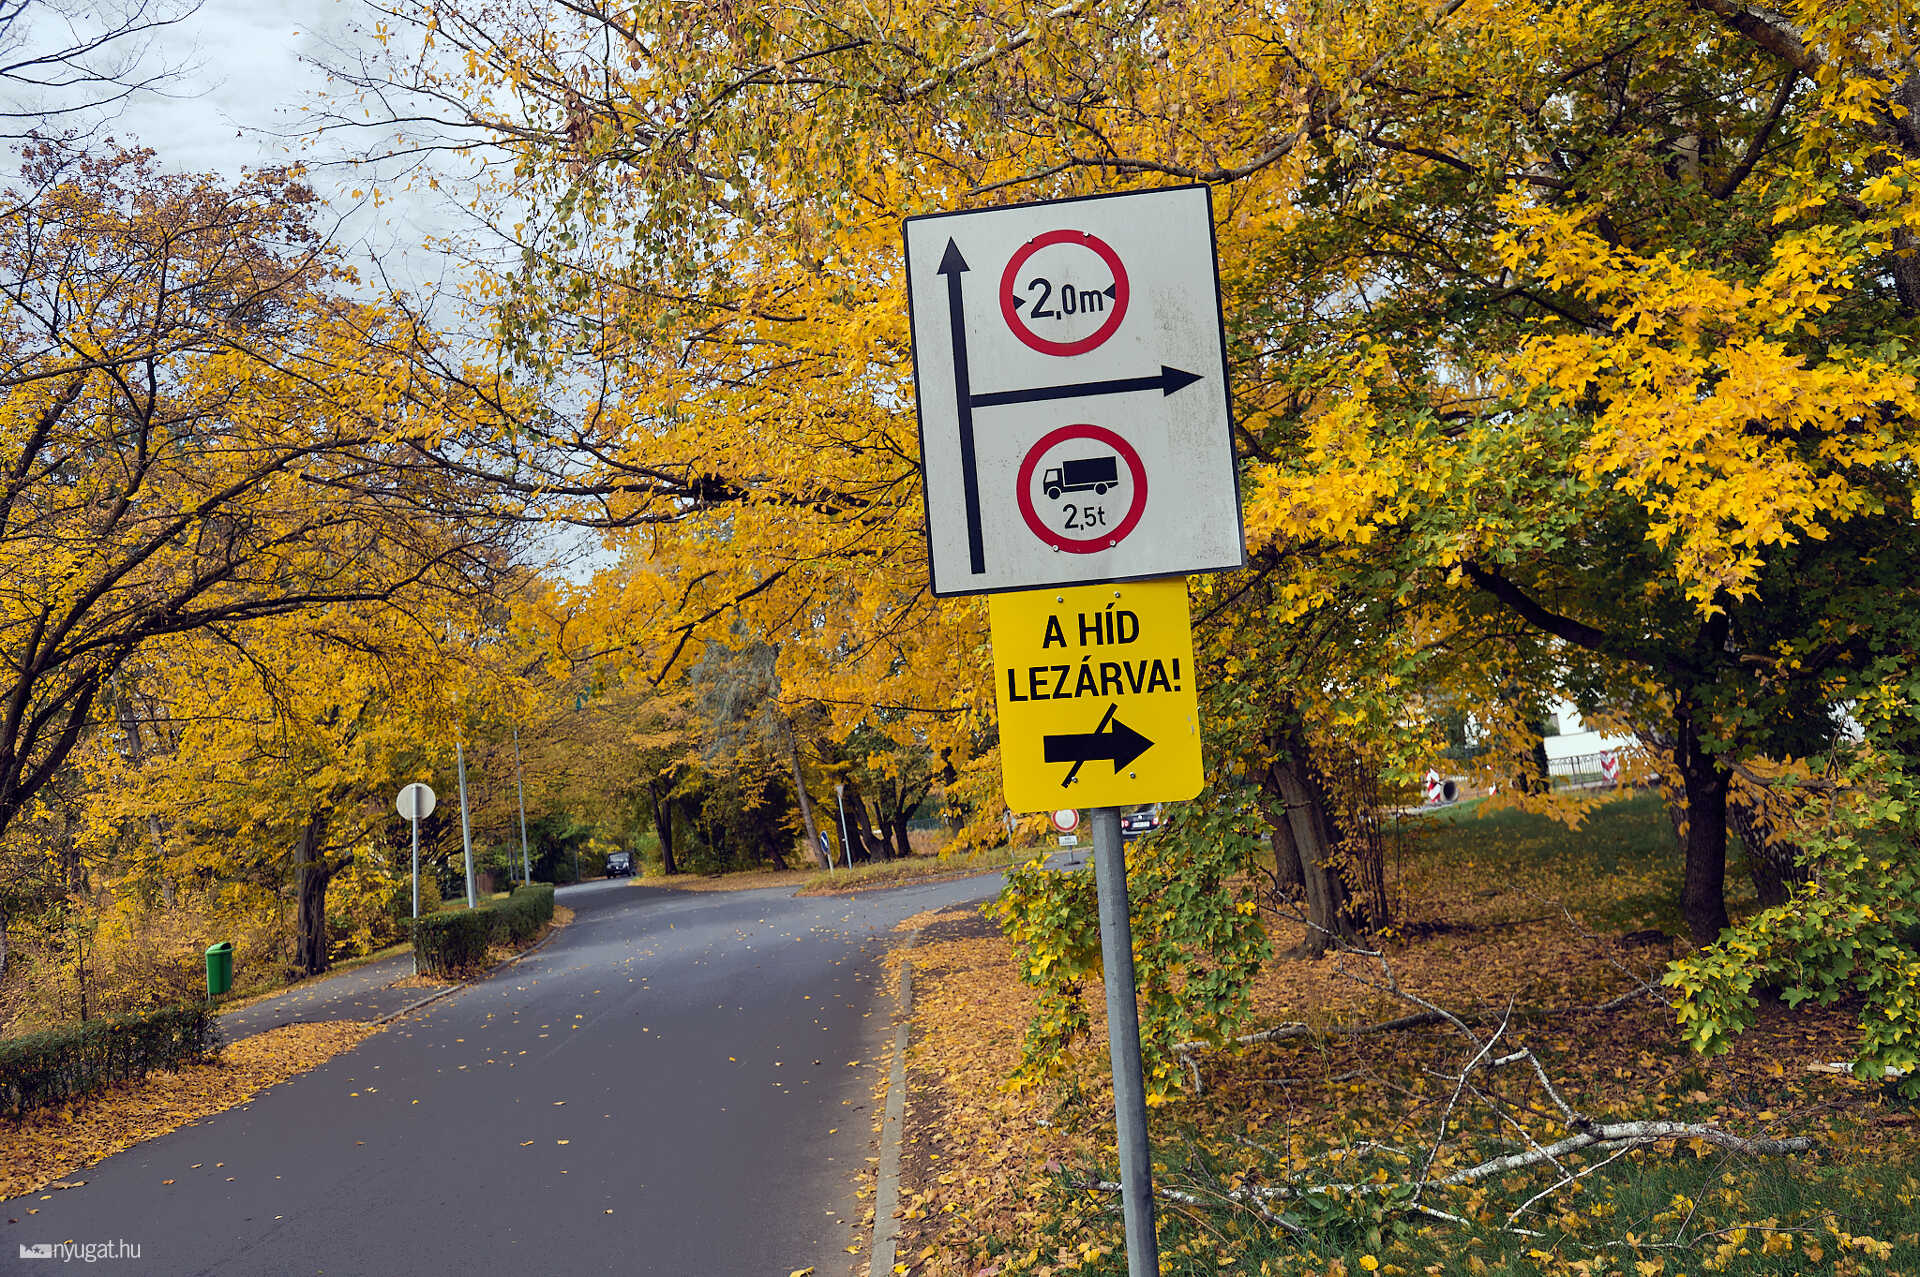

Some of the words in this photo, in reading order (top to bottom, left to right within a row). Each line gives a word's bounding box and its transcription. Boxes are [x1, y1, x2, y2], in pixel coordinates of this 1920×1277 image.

[1027, 277, 1104, 320] 2,0m
[1062, 503, 1106, 531] 2,5t
[1042, 615, 1067, 648] A
[1078, 602, 1140, 646] HÍD
[1007, 655, 1182, 702] LEZÁRVA!
